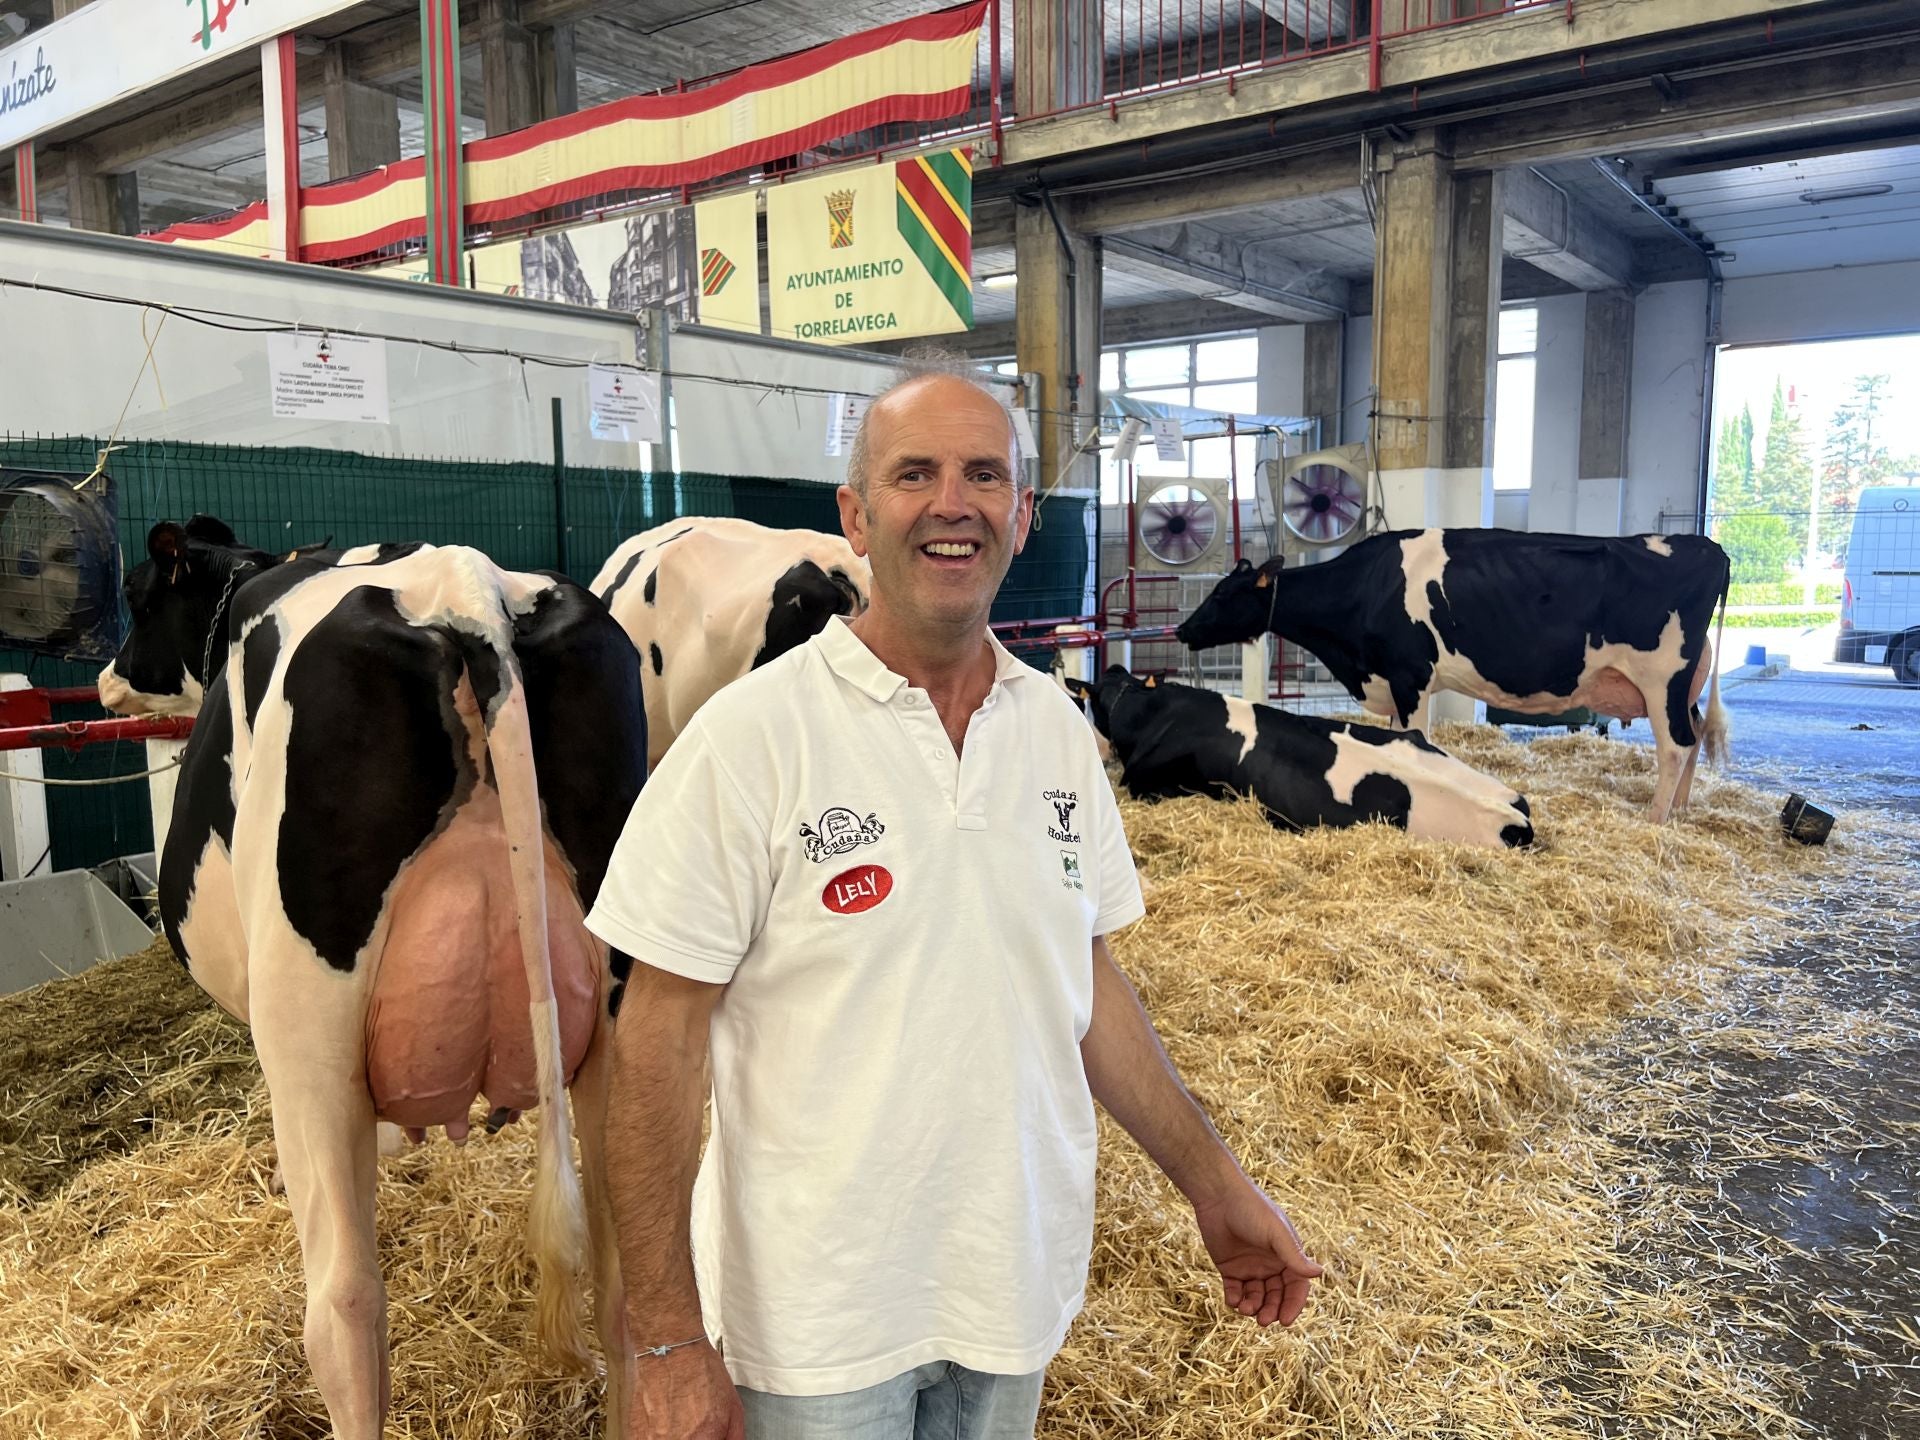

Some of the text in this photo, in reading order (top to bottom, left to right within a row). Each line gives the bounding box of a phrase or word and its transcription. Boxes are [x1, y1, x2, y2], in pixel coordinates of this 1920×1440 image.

[0, 46, 56, 115] nízate
[786, 258, 904, 291] AYUNTAMIENTO
[835, 292, 853, 309] DE
[794, 312, 897, 339] TORRELAVEGA
[1042, 789, 1079, 802] Cudañ
[823, 832, 870, 855] Cudaña
[1047, 825, 1081, 843] Holstei
[834, 871, 878, 907] LELY
